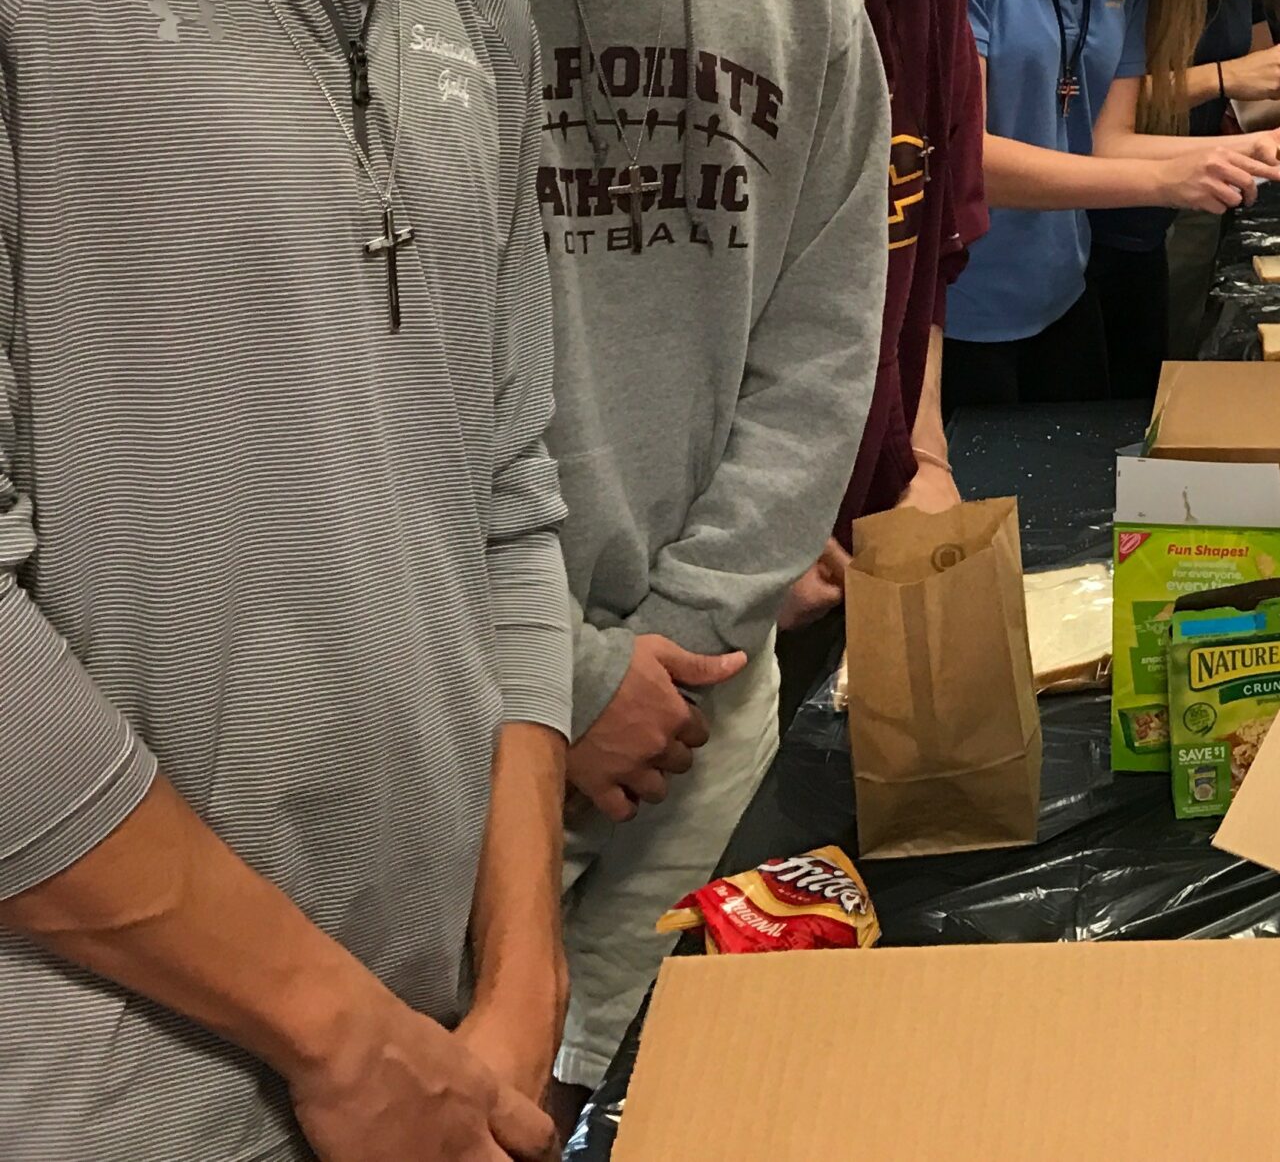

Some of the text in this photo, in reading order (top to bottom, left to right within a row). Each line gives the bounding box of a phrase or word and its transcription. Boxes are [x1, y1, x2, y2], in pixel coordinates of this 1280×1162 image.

[541, 45, 784, 140] POINTE
[1167, 544, 1250, 558] Fun Shapes!
[1197, 645, 1280, 684] NATURE
[1179, 747, 1213, 762] SAVE
[1214, 746, 1225, 758] $1
[757, 856, 867, 915] Fritos
[720, 895, 787, 938] ORIGINAL
